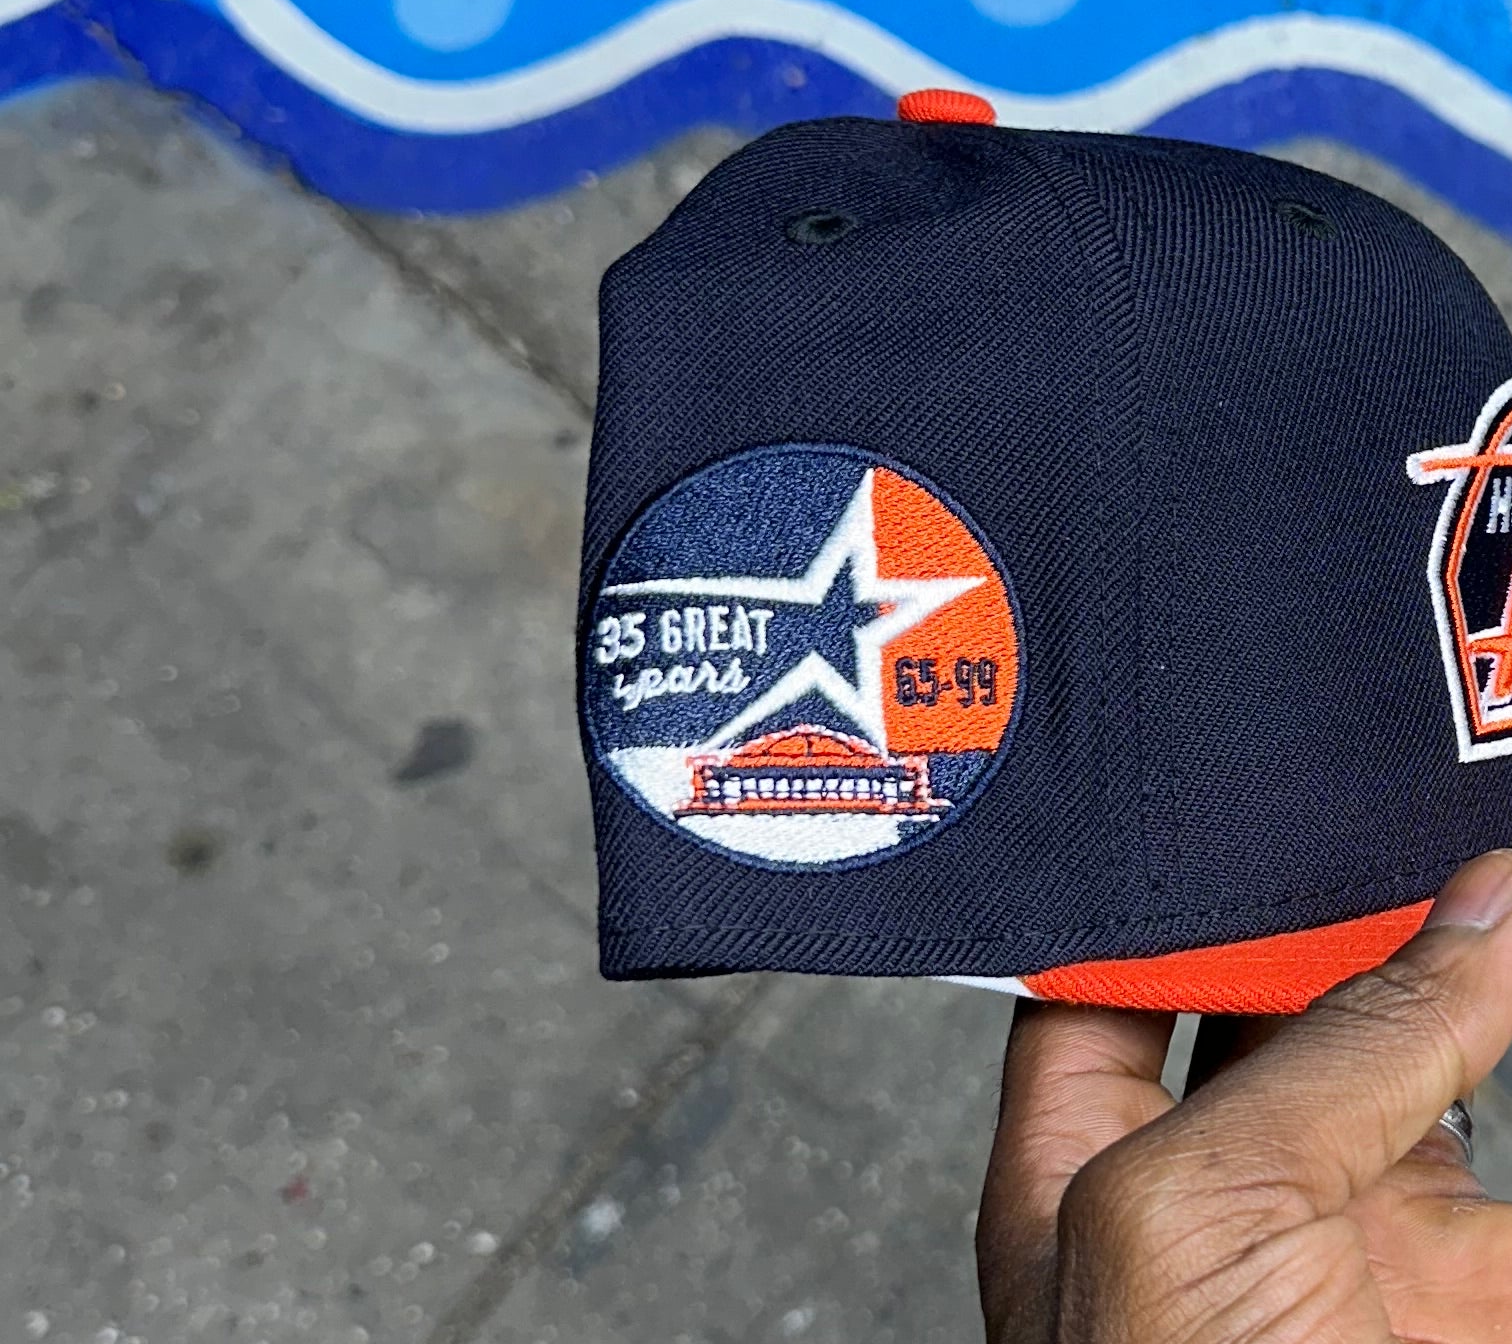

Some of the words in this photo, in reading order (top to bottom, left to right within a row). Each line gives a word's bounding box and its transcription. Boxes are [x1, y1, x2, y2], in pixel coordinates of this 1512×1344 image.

[597, 612, 647, 664] 35
[659, 605, 775, 657] GREAT
[612, 657, 752, 712] years
[895, 655, 998, 709] 65-99
